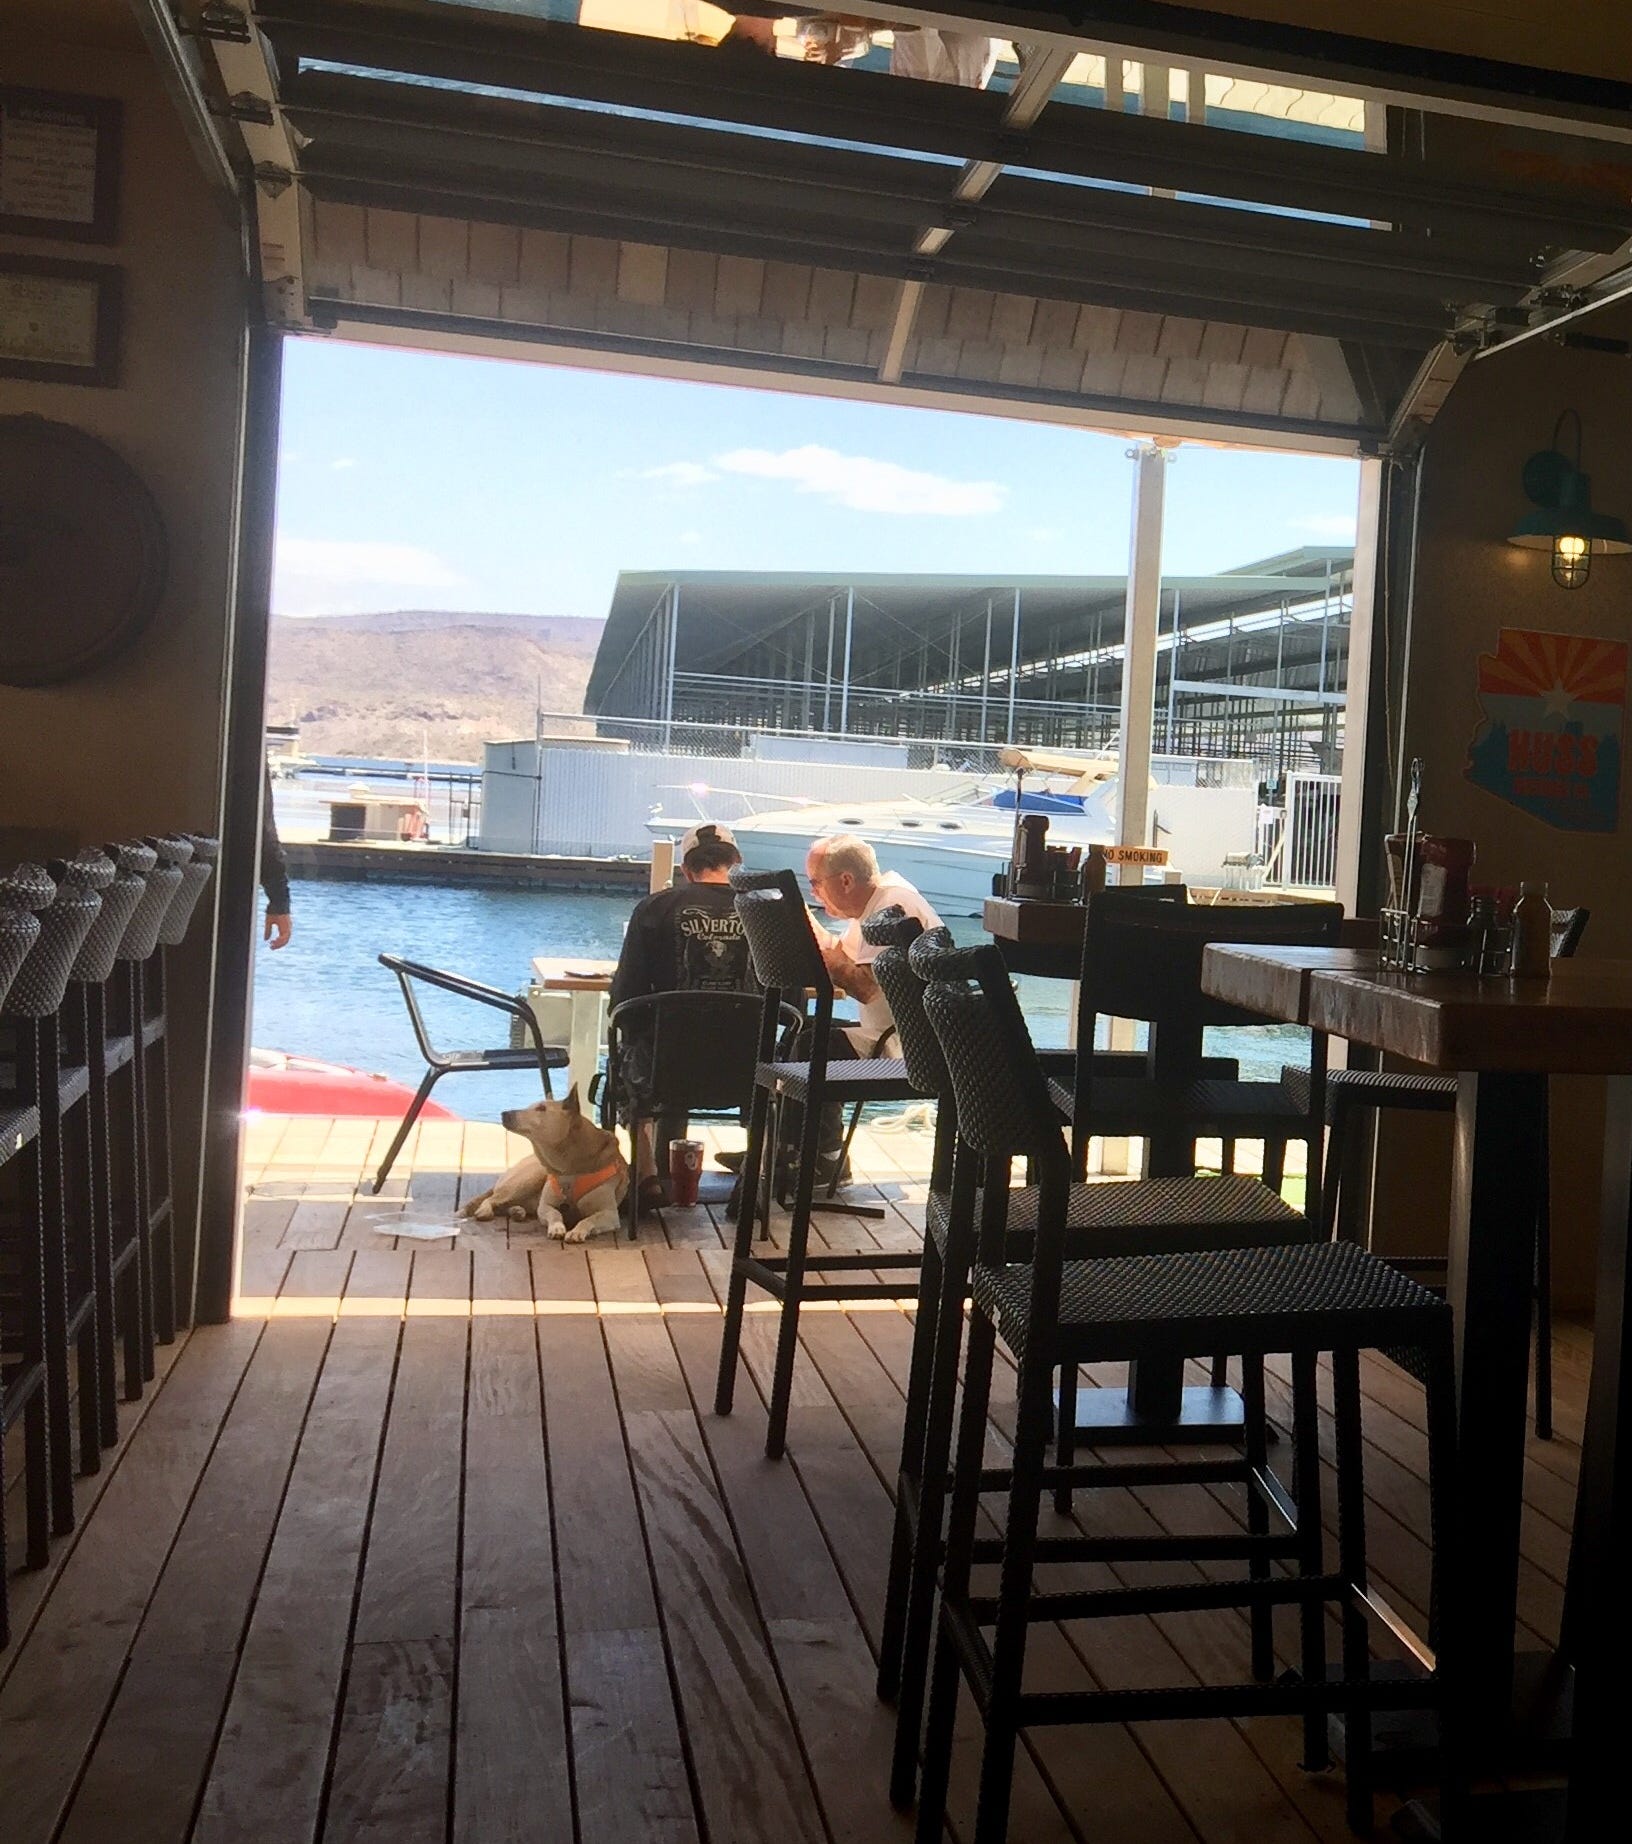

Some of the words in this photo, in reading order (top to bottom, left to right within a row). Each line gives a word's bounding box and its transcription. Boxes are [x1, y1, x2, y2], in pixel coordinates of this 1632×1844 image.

[1508, 729, 1598, 777] HUSS
[1118, 849, 1163, 864] SMOKING
[680, 918, 745, 937] SILVERTO
